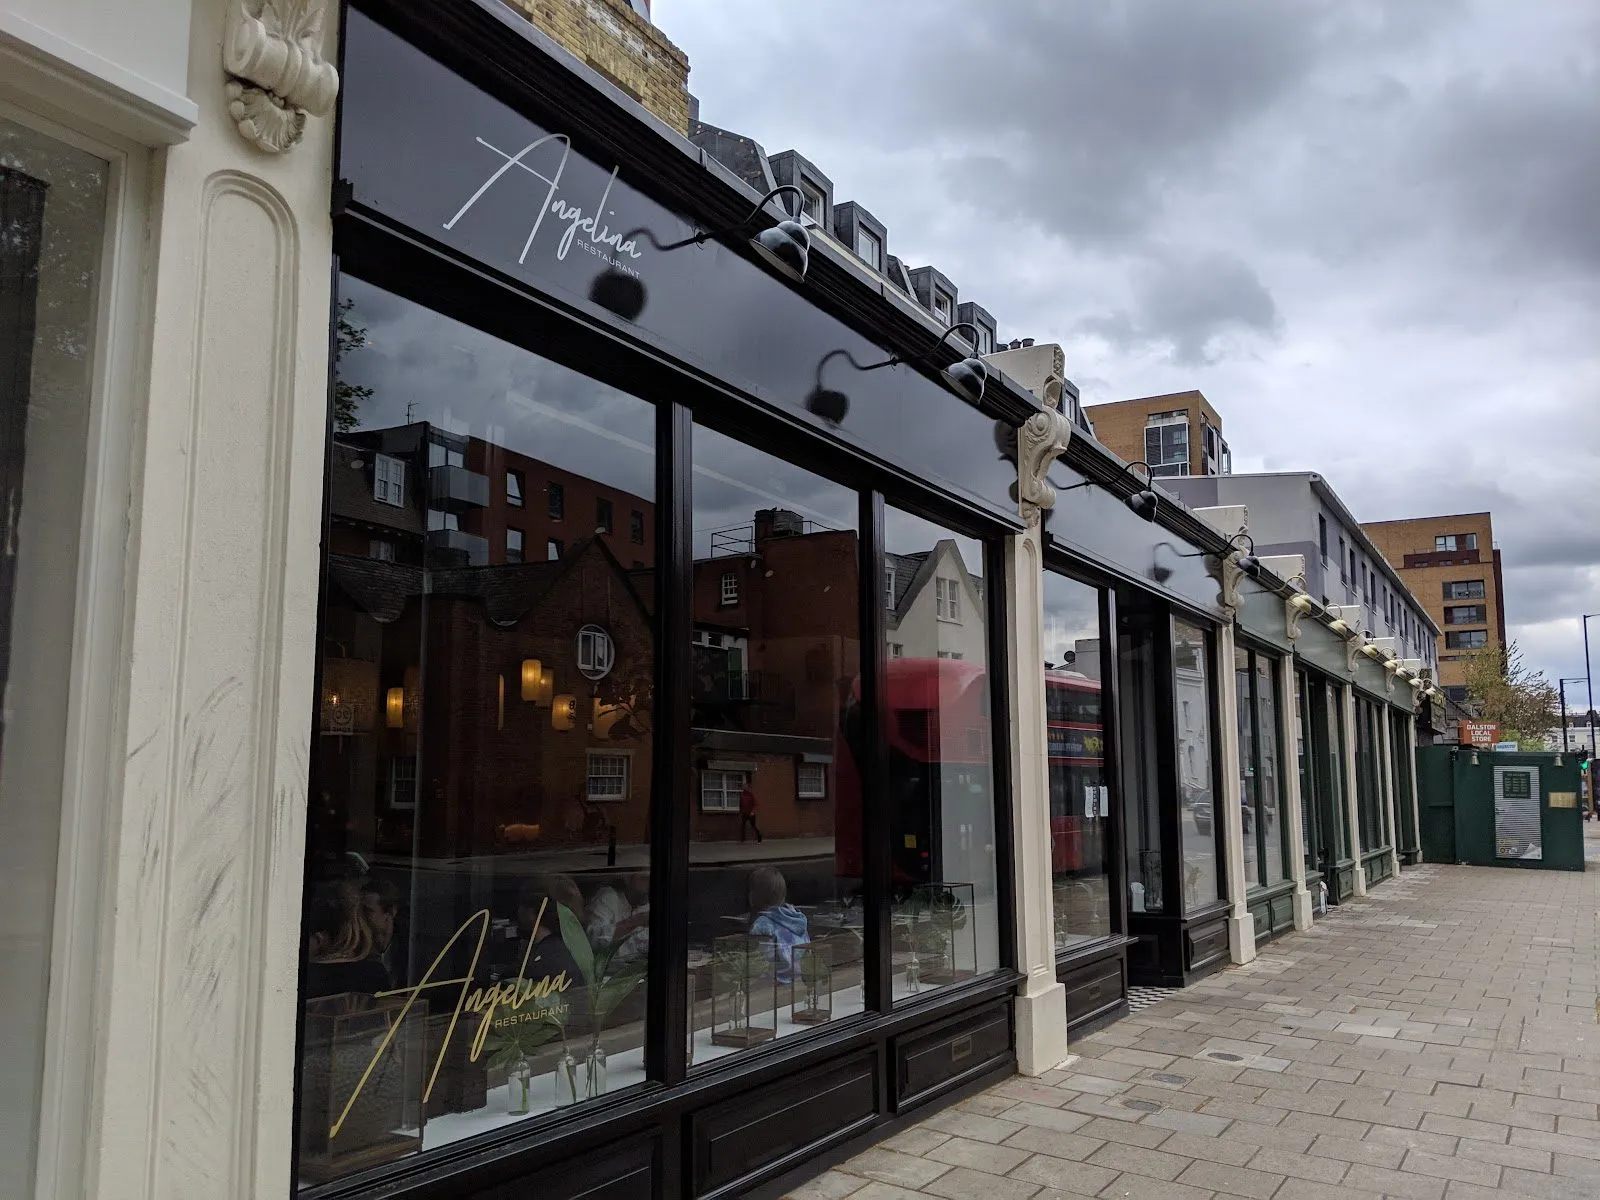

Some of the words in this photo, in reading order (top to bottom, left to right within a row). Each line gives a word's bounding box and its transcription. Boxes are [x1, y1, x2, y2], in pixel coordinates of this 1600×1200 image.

[443, 133, 642, 264] Angelina
[576, 238, 641, 279] RESTAURANT
[330, 897, 573, 1138] Angelina
[495, 1003, 571, 1028] RESTAURANT
